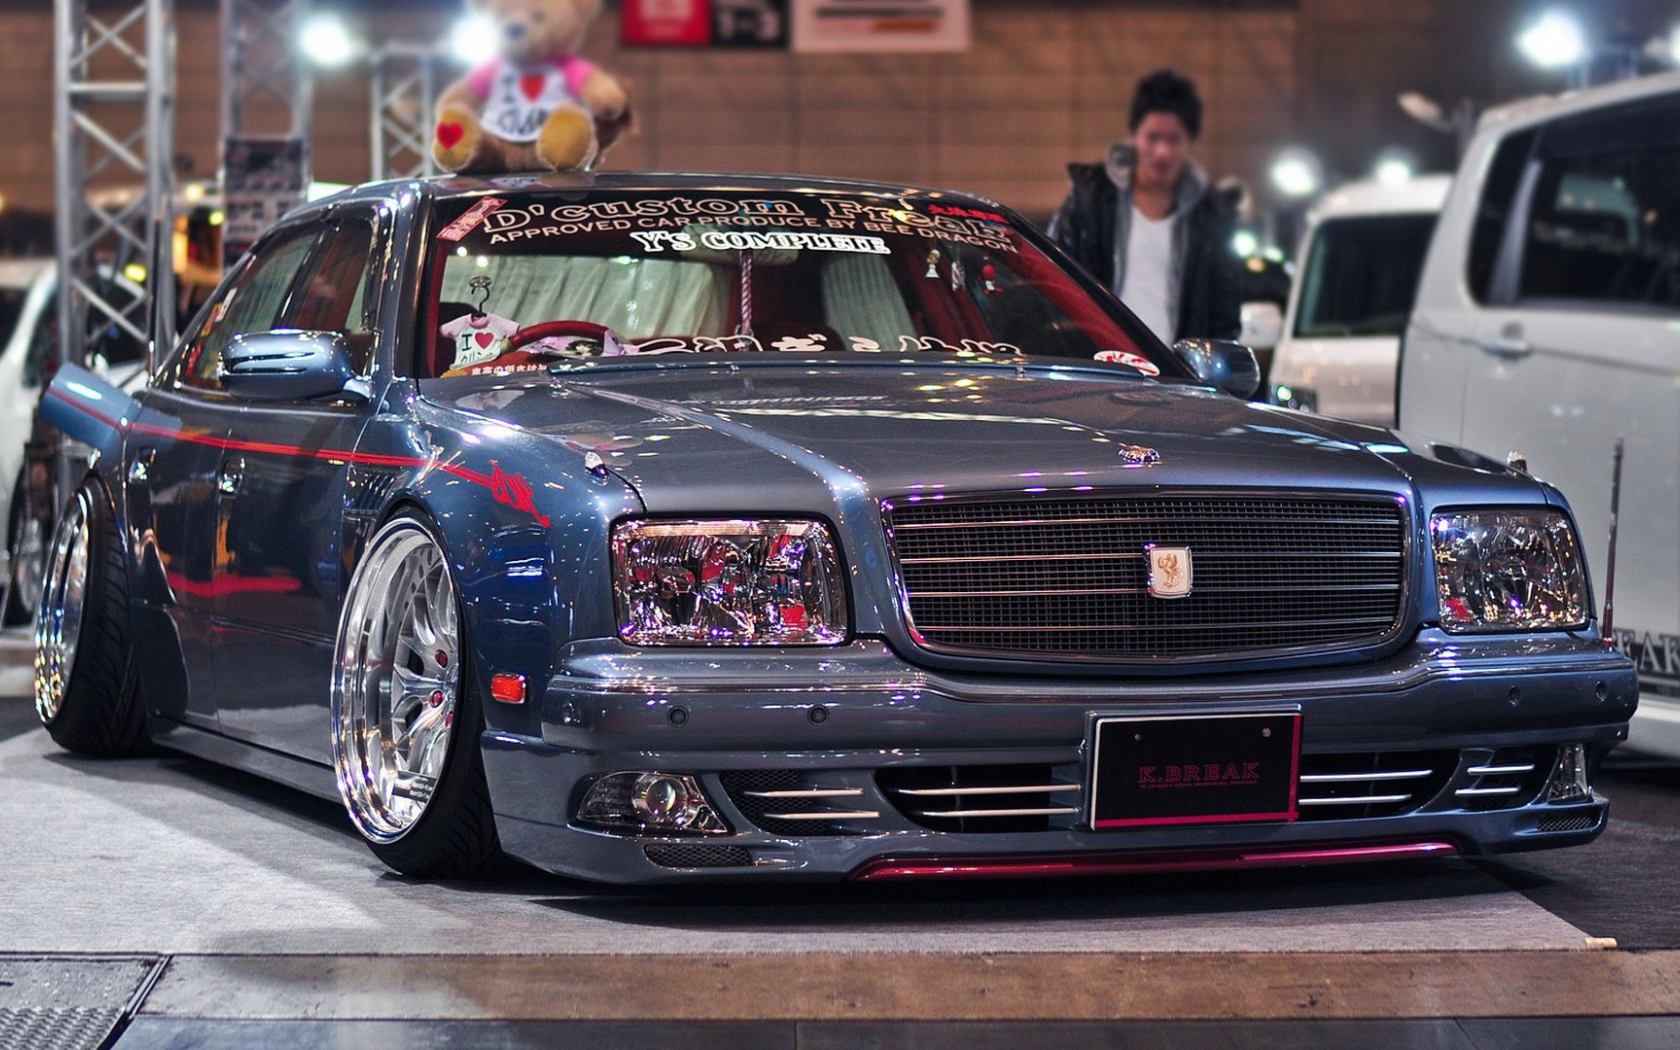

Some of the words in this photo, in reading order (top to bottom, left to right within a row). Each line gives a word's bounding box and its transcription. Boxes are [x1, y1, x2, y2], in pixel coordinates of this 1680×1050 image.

[490, 218, 631, 244] APPROVED
[638, 215, 692, 227] CAR
[699, 215, 822, 228] PRODUCE
[825, 218, 856, 230] BY
[863, 221, 912, 236] BEE
[919, 223, 1019, 254] DRAGON
[700, 231, 891, 255] COMPLETE
[1139, 762, 1260, 783] K.BREAK
